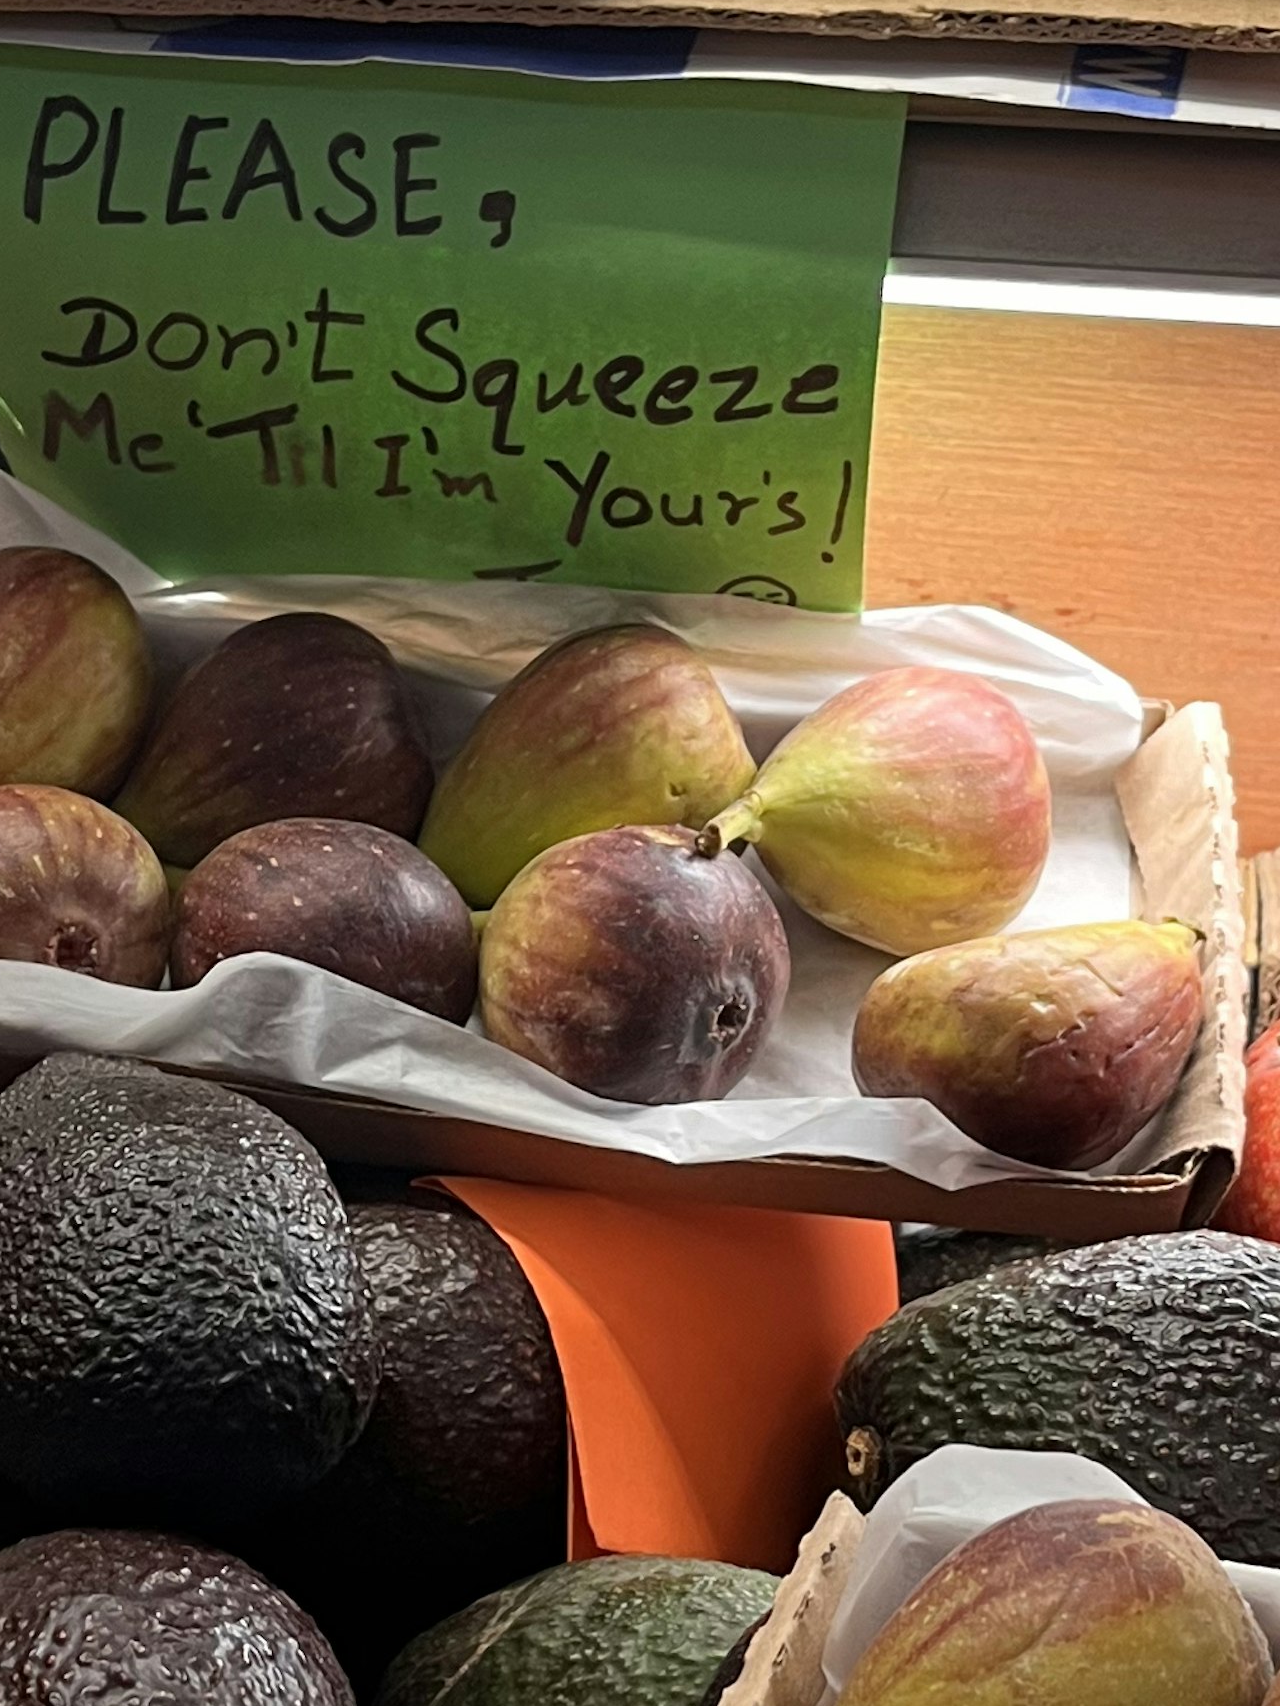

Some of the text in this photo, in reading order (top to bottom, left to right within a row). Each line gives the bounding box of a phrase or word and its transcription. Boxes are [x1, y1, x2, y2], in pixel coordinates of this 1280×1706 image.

[21, 93, 516, 249] PLEASE,
[40, 287, 840, 456] Don't Squeeze
[41, 389, 177, 474] Me
[373, 425, 500, 504] I'm
